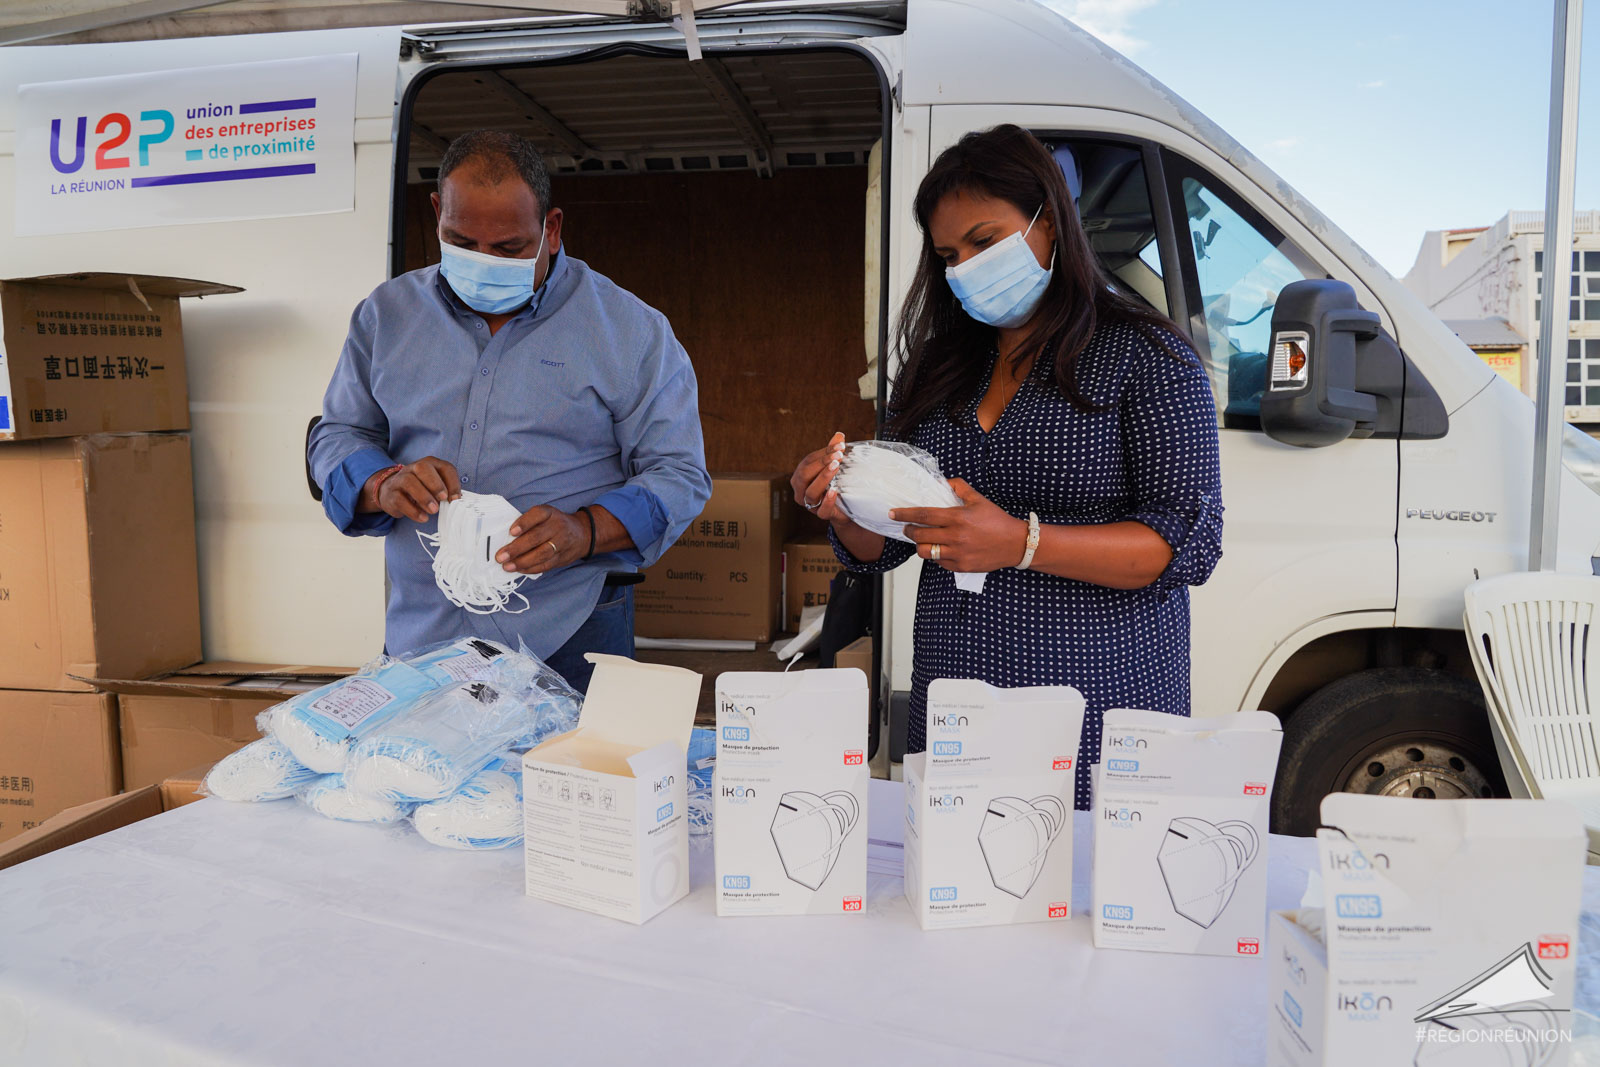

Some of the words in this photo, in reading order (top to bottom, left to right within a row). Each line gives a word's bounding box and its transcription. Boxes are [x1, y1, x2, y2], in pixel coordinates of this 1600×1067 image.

[186, 103, 234, 120] union
[185, 124, 214, 141] des
[218, 117, 316, 138] entreprises
[49, 109, 175, 174] U2P
[208, 144, 229, 160] de
[233, 135, 316, 161] proximité
[51, 183, 67, 195] LA
[70, 178, 126, 194] RÉUNION
[43, 355, 165, 380] 一次性平面口罩
[1406, 507, 1497, 523] PEUGEOT
[729, 571, 748, 583] PCS
[724, 727, 748, 740] KN95
[935, 742, 960, 754] KN95
[845, 755, 861, 764] x20
[1054, 761, 1070, 769] x20
[1109, 761, 1137, 771] KN95
[1245, 787, 1264, 795] x20
[725, 877, 748, 888] KN95
[931, 888, 955, 900] KN95
[844, 902, 860, 910] x20
[1338, 897, 1379, 917] KN95
[1050, 908, 1065, 917] x20
[1105, 906, 1131, 919] KN95
[1240, 945, 1257, 953] x20
[1541, 945, 1566, 957] x20
